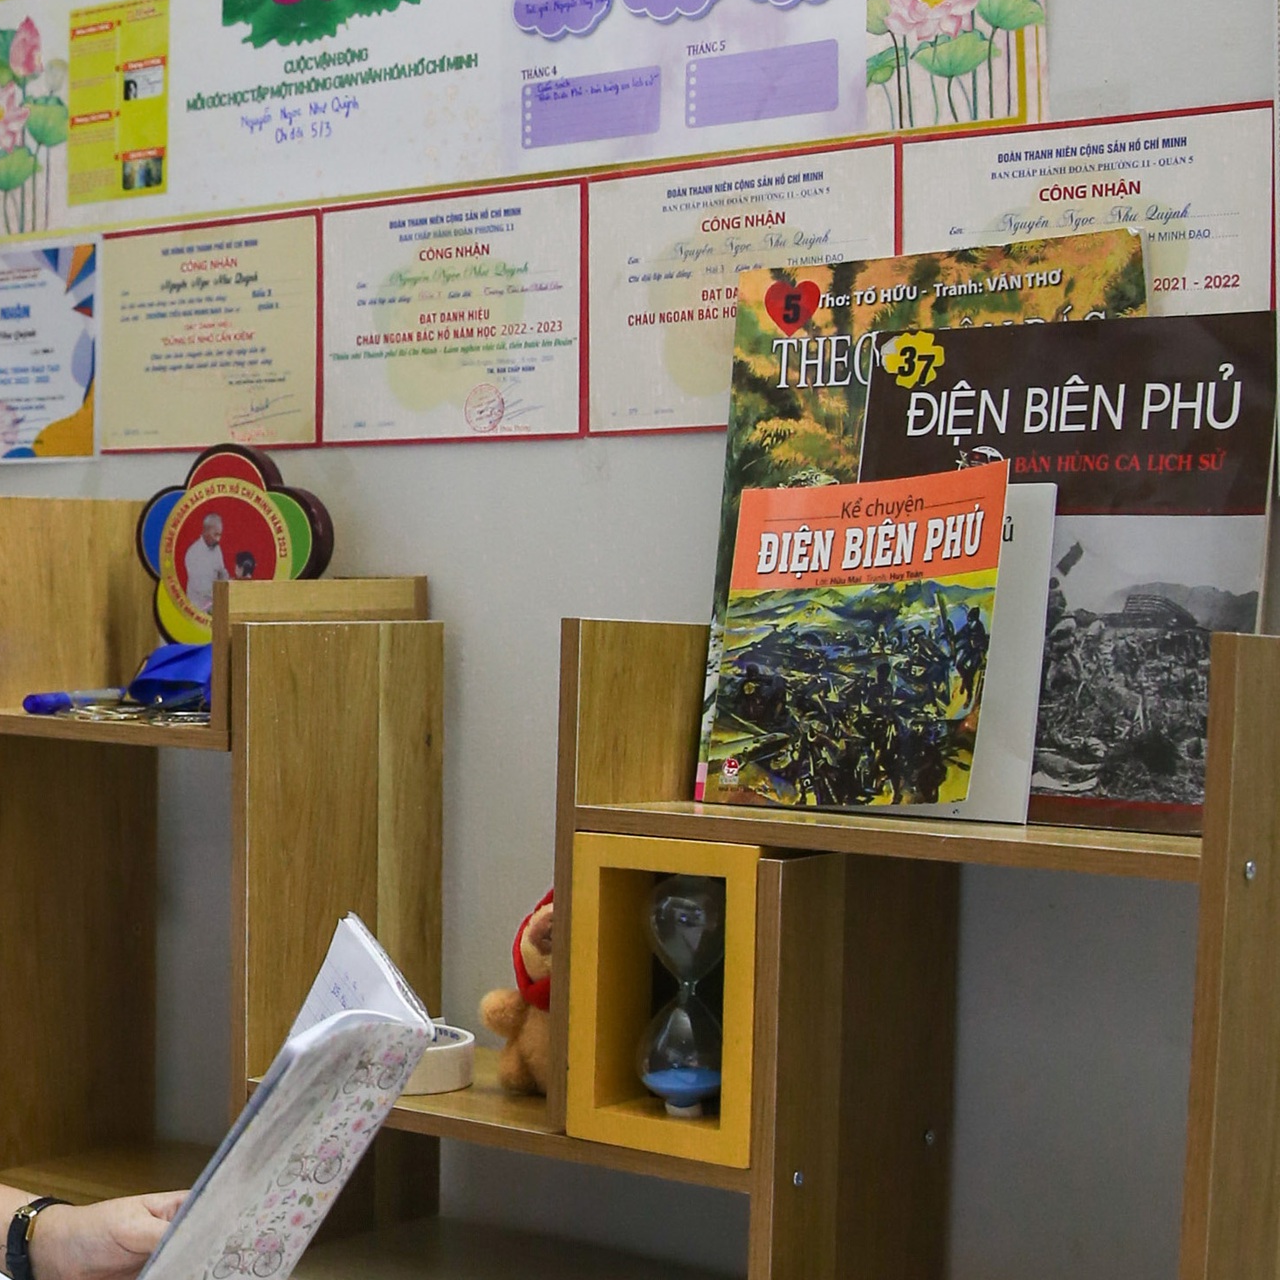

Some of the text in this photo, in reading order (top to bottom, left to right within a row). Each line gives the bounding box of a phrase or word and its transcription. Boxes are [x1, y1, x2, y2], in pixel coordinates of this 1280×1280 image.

[997, 136, 1187, 165] ĐOÀN THANH NIÊN CỘNG SẢN HỒ CHÍ MINH
[991, 171, 1008, 181] BAN
[1010, 167, 1037, 180] CHẤP
[1039, 165, 1067, 177] HÀNH
[1068, 162, 1096, 174] ĐOÀN
[1098, 158, 1140, 171] PHƯỜNG
[667, 171, 823, 199] ĐOÀN THANH NIÊN CỘNG SẢN HỒ CHÍ MINH
[1039, 180, 1141, 202] CÔNG NHẬN
[701, 211, 786, 233] CÔNG NHẬN
[1158, 229, 1186, 241] MINH
[419, 243, 490, 261] CÔNG NHẬN
[787, 256, 823, 266] TH MINH
[701, 287, 723, 303] ĐẠT
[818, 268, 1062, 311] Thơ: TỐ HỮU Tranh: VĂN THƠ
[1153, 274, 1240, 293] 2021 2022
[440, 311, 464, 322] DANH
[467, 308, 490, 321] HIỆU
[627, 312, 656, 327] CHÁU
[659, 310, 695, 324] NGOAN
[698, 306, 719, 321] BÁC
[782, 294, 801, 324] 5
[383, 332, 413, 344] NGOAN
[416, 329, 434, 342] BÁC
[476, 325, 497, 338] HỌC
[501, 323, 527, 336] 2022
[536, 320, 563, 333] 2023
[898, 346, 936, 387] 37
[907, 362, 1242, 446] ĐIỆN BIÊN PHỦ
[1014, 448, 1227, 476] BẢN HÙNG CA LỊCH SỬ
[840, 495, 925, 520] Kể chuyện
[756, 524, 837, 579] ĐIỆN
[841, 517, 918, 570] BIÊN
[923, 503, 985, 562] PHỦ
[889, 572, 904, 582] Huy
